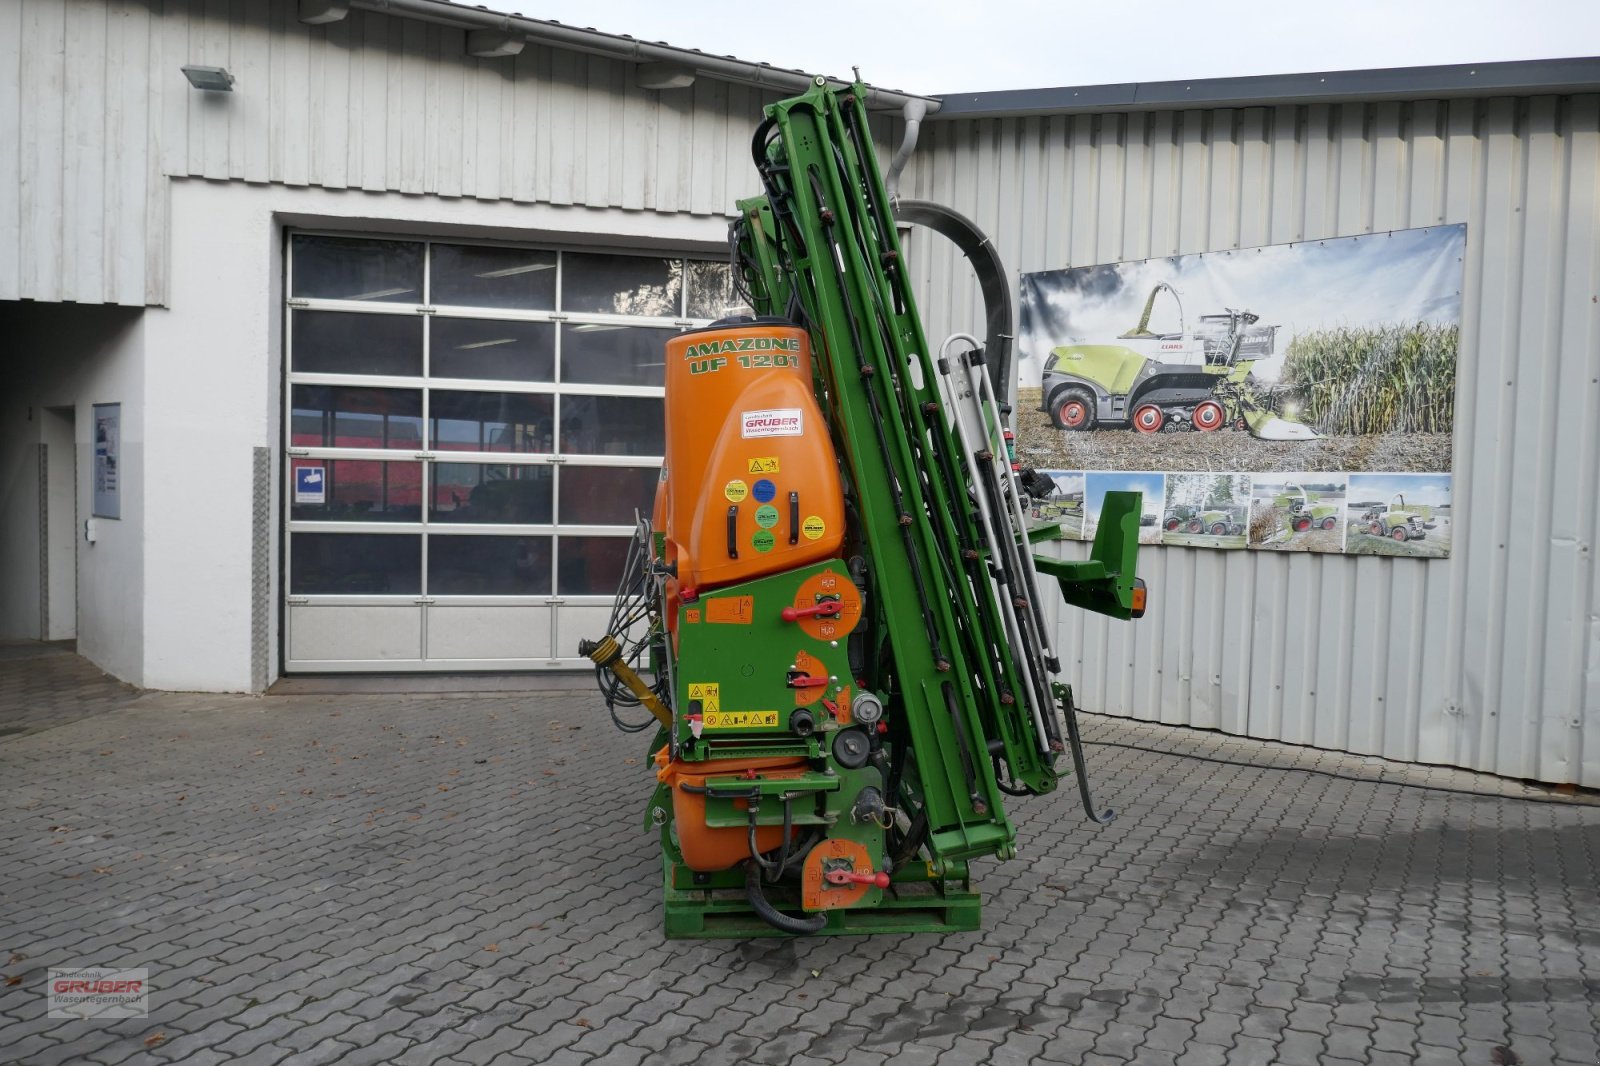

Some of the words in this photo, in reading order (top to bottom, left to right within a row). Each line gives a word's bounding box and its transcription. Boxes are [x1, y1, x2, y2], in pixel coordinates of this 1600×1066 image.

[685, 337, 800, 360] AMAZONE
[690, 357, 728, 375] UF
[737, 354, 799, 368] 1201
[745, 417, 798, 427] GRUBER
